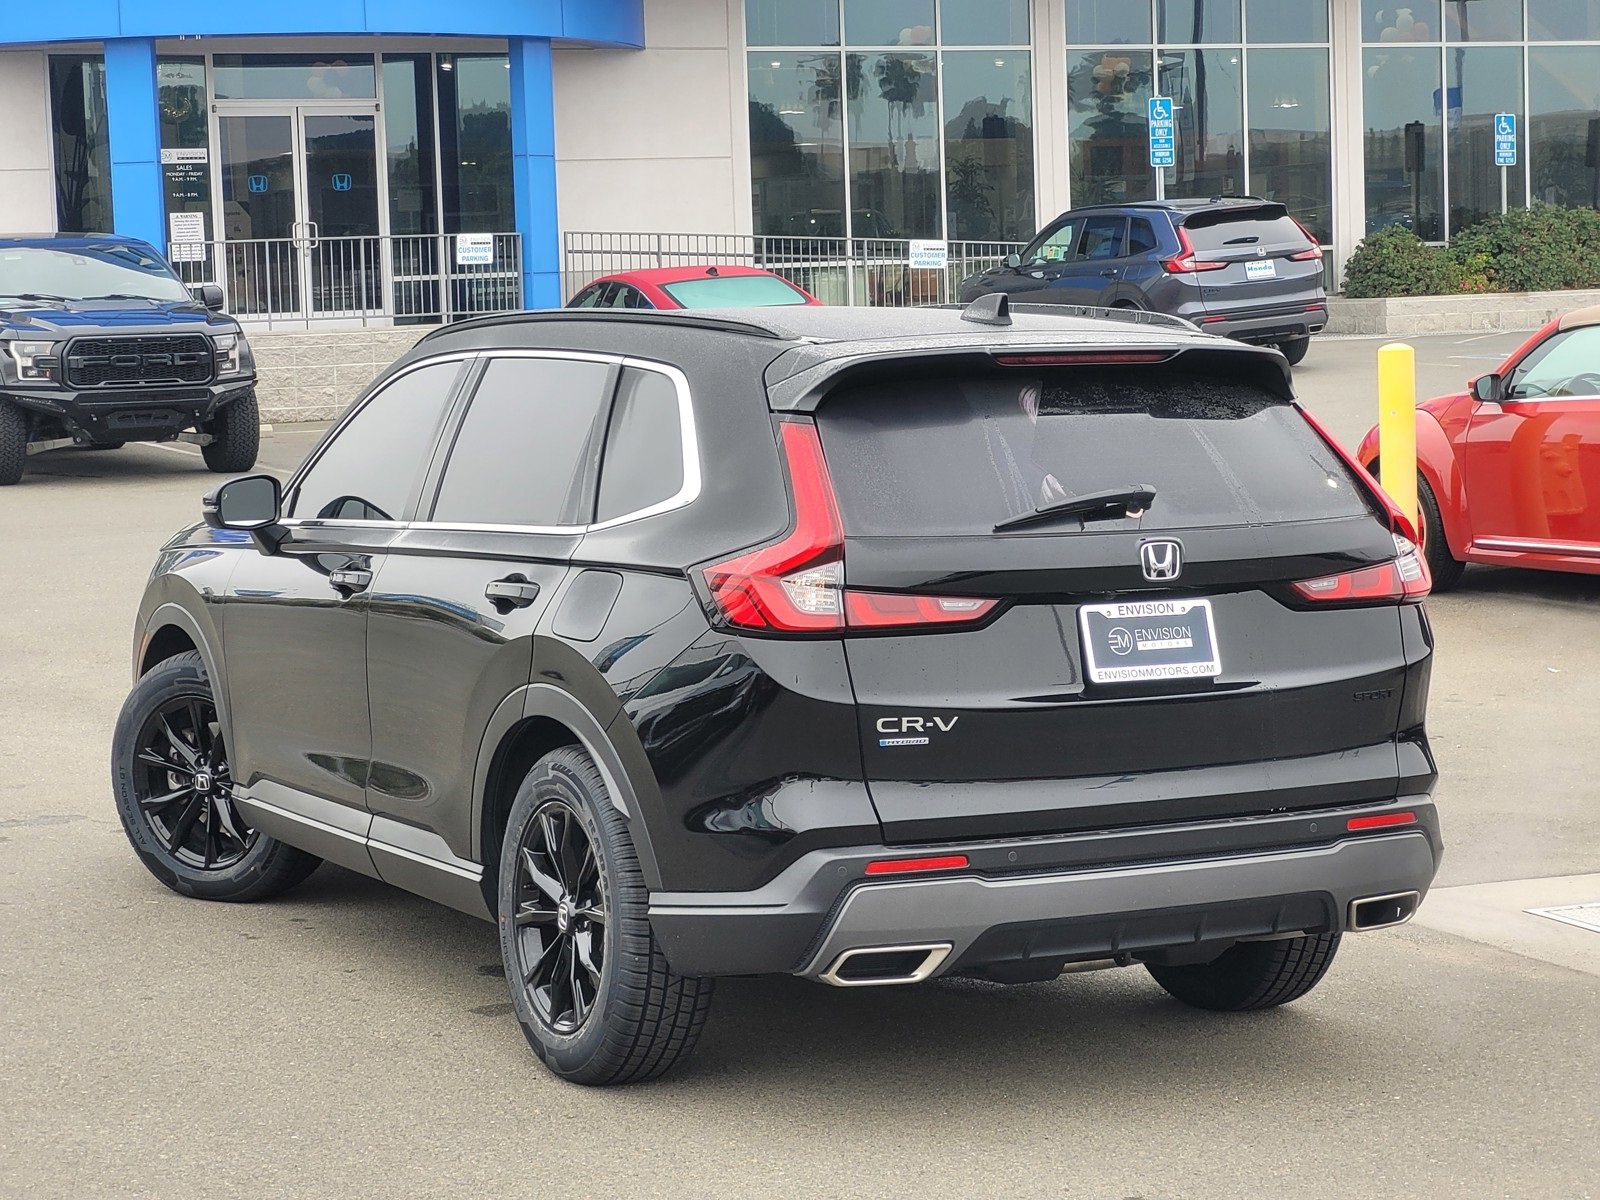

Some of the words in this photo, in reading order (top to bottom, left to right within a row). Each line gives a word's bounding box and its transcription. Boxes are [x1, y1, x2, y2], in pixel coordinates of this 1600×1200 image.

[1151, 120, 1172, 128] PARKING
[1155, 128, 1168, 136] ONLY
[68, 351, 208, 368] FORD
[1118, 603, 1174, 616] ENVISION
[1134, 626, 1192, 641] ENVISION
[1140, 640, 1190, 649] MOTORS
[1097, 664, 1216, 681] ENVISIONMOTORS.COM
[1353, 688, 1394, 701] SPORT
[876, 716, 958, 732] CR-V
